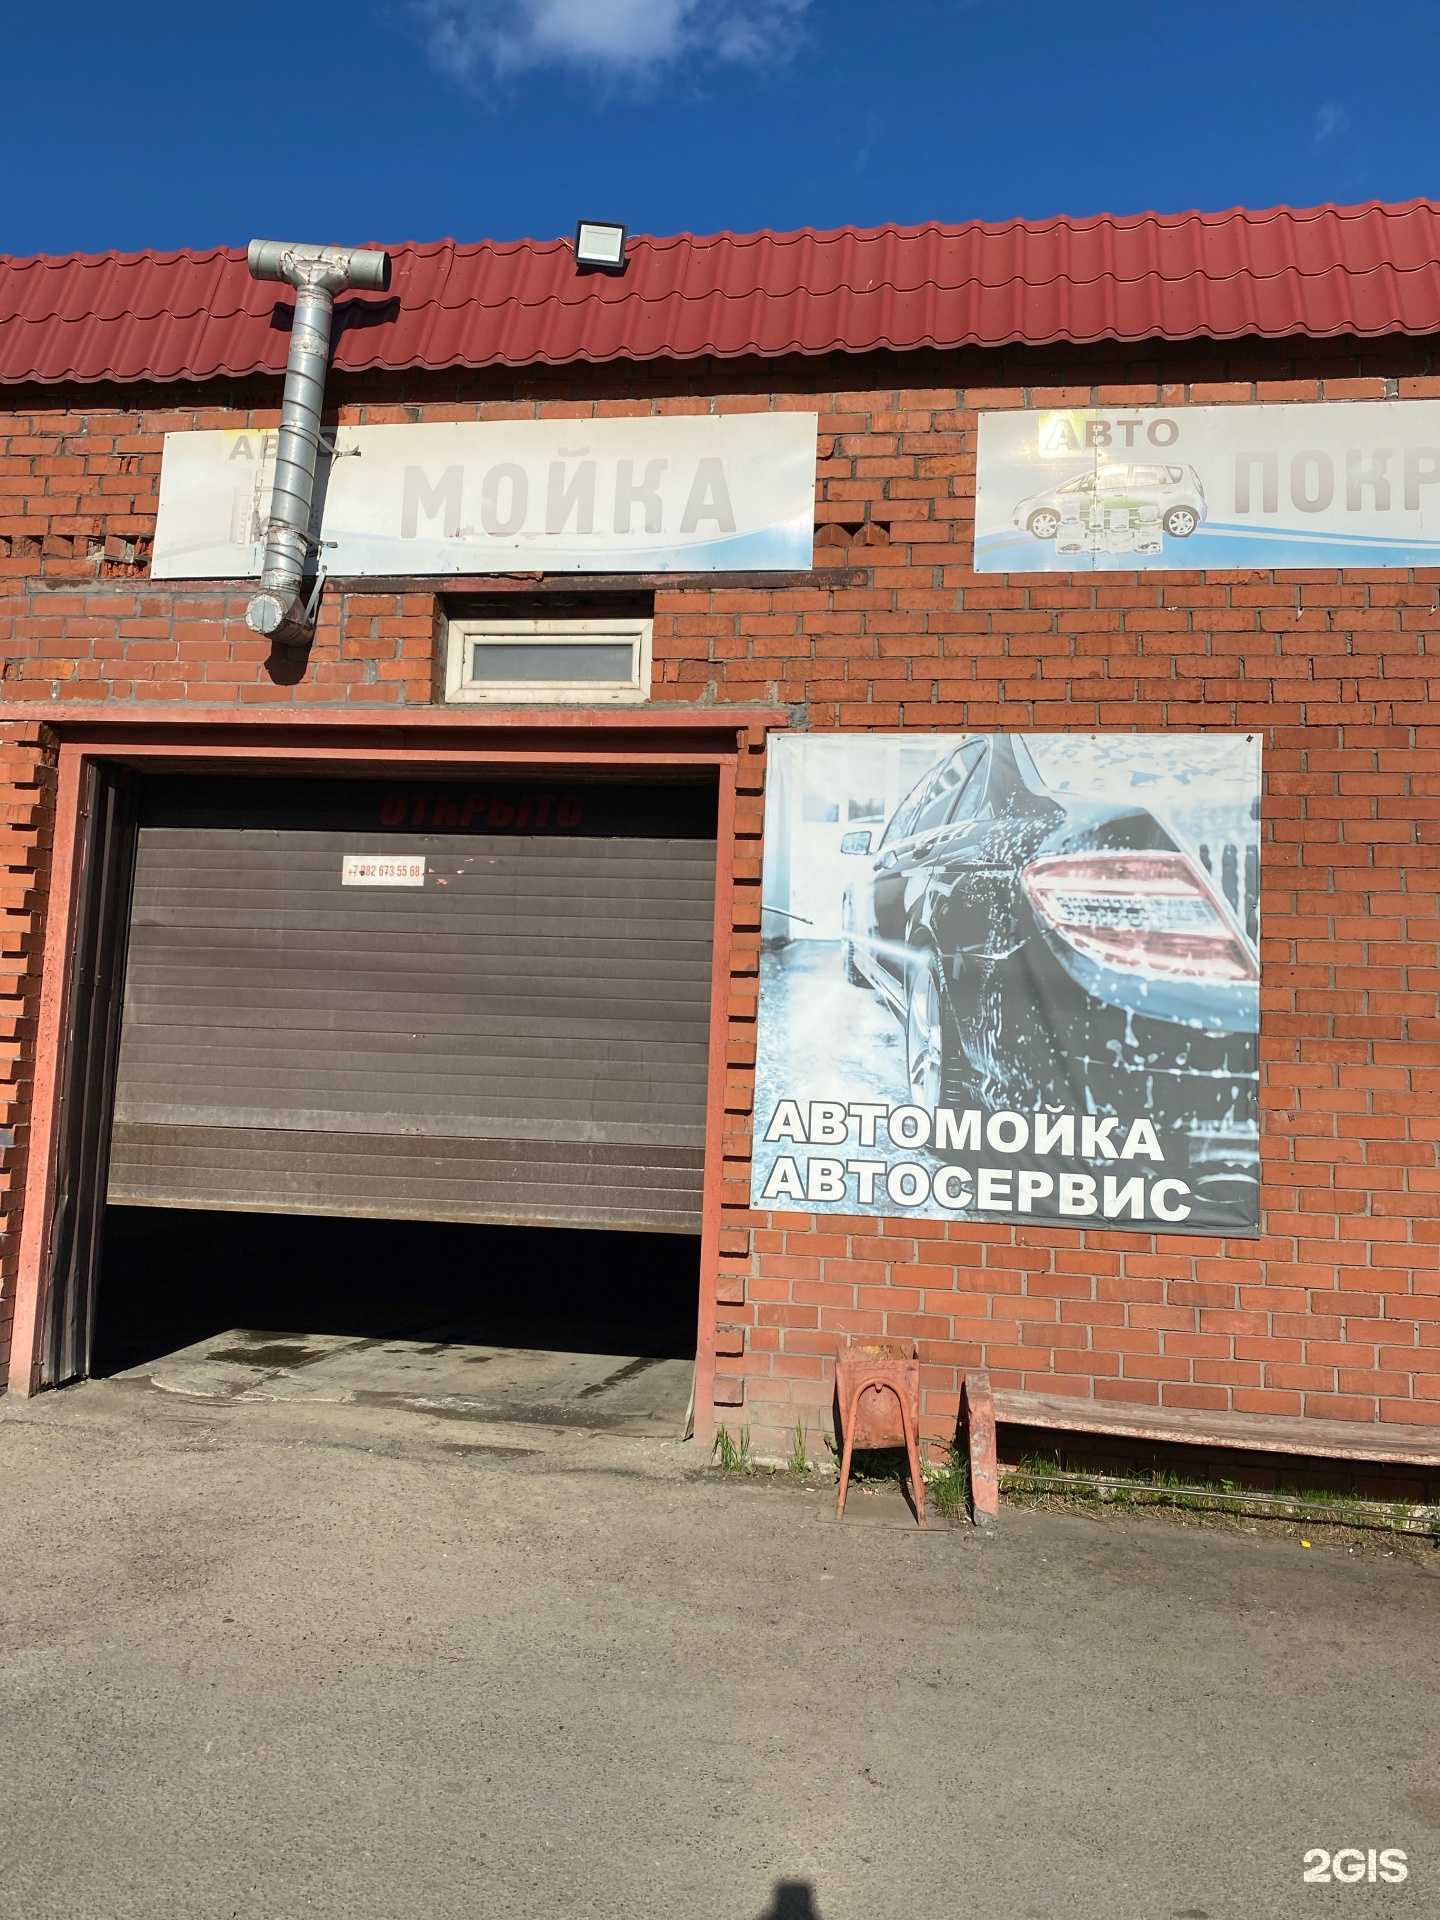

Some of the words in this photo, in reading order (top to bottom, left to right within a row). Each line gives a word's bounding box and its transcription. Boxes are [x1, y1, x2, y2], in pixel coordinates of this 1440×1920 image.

[1046, 418, 1180, 450] АВТО
[400, 447, 737, 539] МОЙКА
[378, 791, 585, 827] ОТКРЫТО
[379, 864, 395, 877] 673
[397, 865, 407, 877] 55
[410, 865, 420, 877] 68
[763, 1099, 1165, 1161] АВТОМОЙКА
[761, 1157, 1193, 1221] АВТОСЕРВИС
